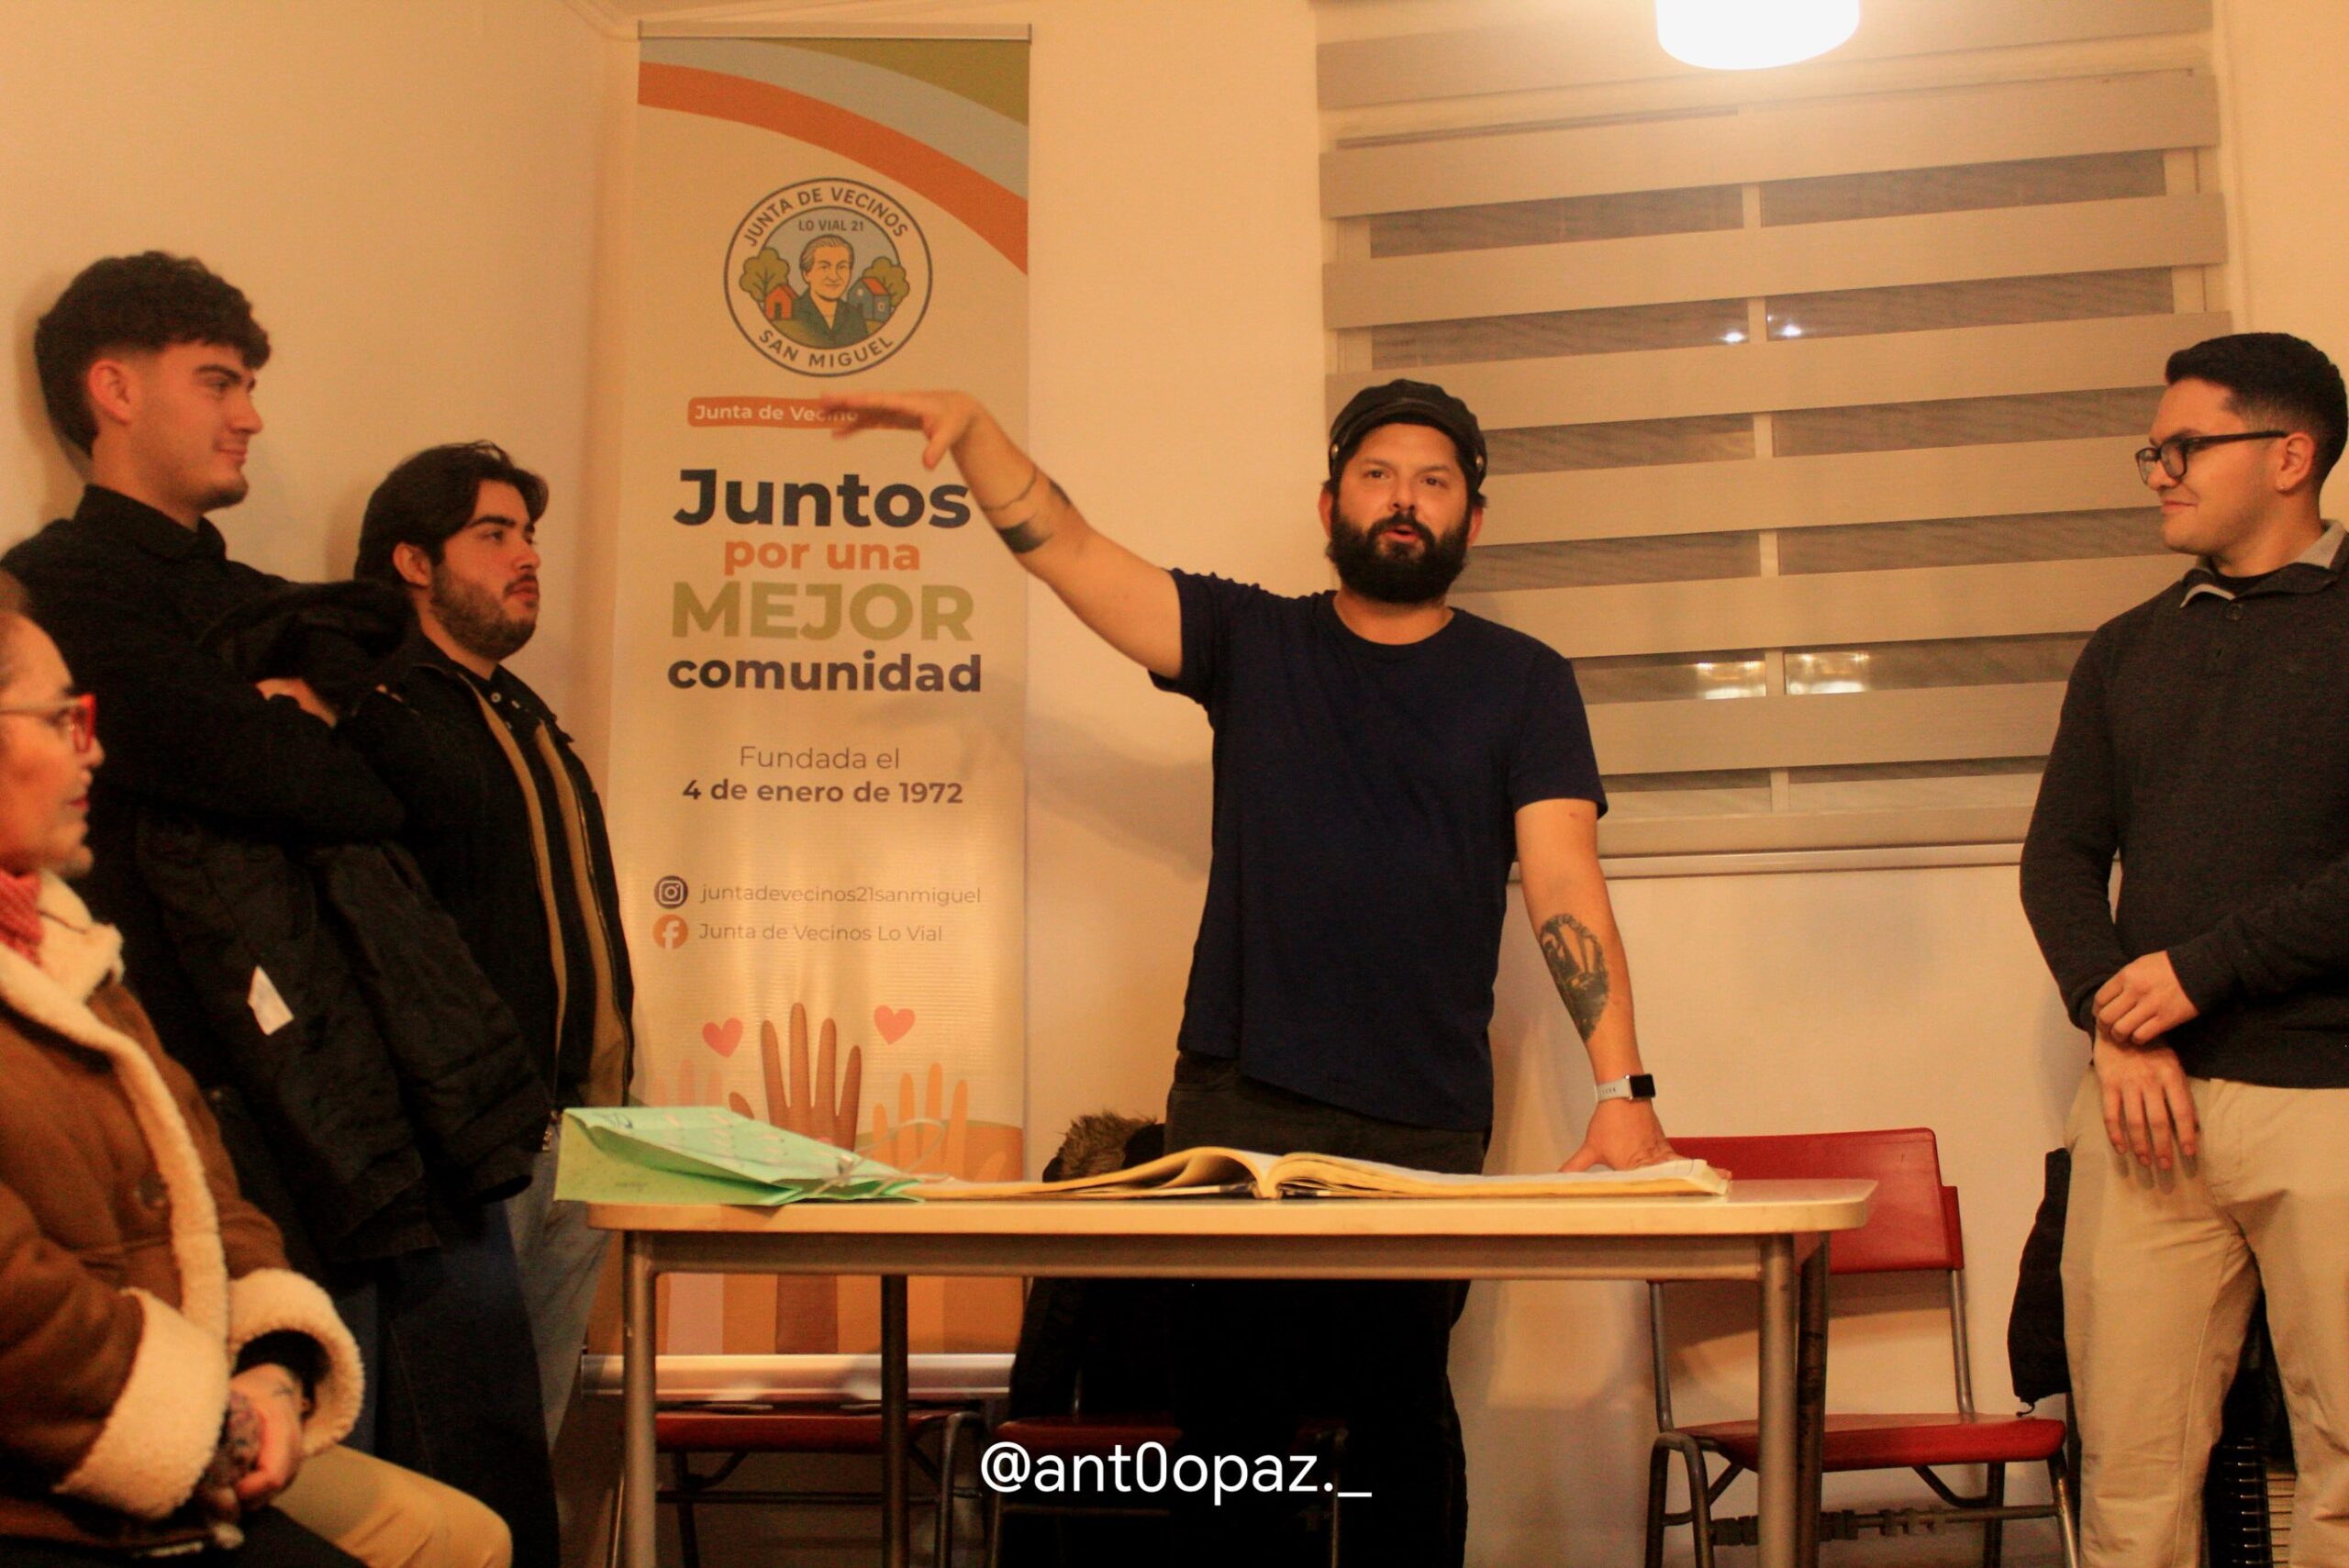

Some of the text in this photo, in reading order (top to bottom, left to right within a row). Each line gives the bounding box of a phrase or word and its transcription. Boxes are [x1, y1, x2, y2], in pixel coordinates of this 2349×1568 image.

[743, 186, 907, 247] JUNTA DE VECINOS
[798, 219, 863, 231] LO VIAL 21
[759, 329, 894, 368] SAN MIGUEL
[695, 405, 859, 422] Junta de Vecino
[673, 468, 971, 528] Juntos
[724, 539, 920, 575] por una
[672, 581, 974, 641] MEJOR
[667, 650, 982, 693] comunidad
[740, 745, 899, 770] Fundada el
[682, 778, 963, 804] 4 de enero de 1972
[699, 884, 982, 906] juntadevecinos21sanmiguel
[698, 923, 943, 942] Junta de Vecinos Lo Vial
